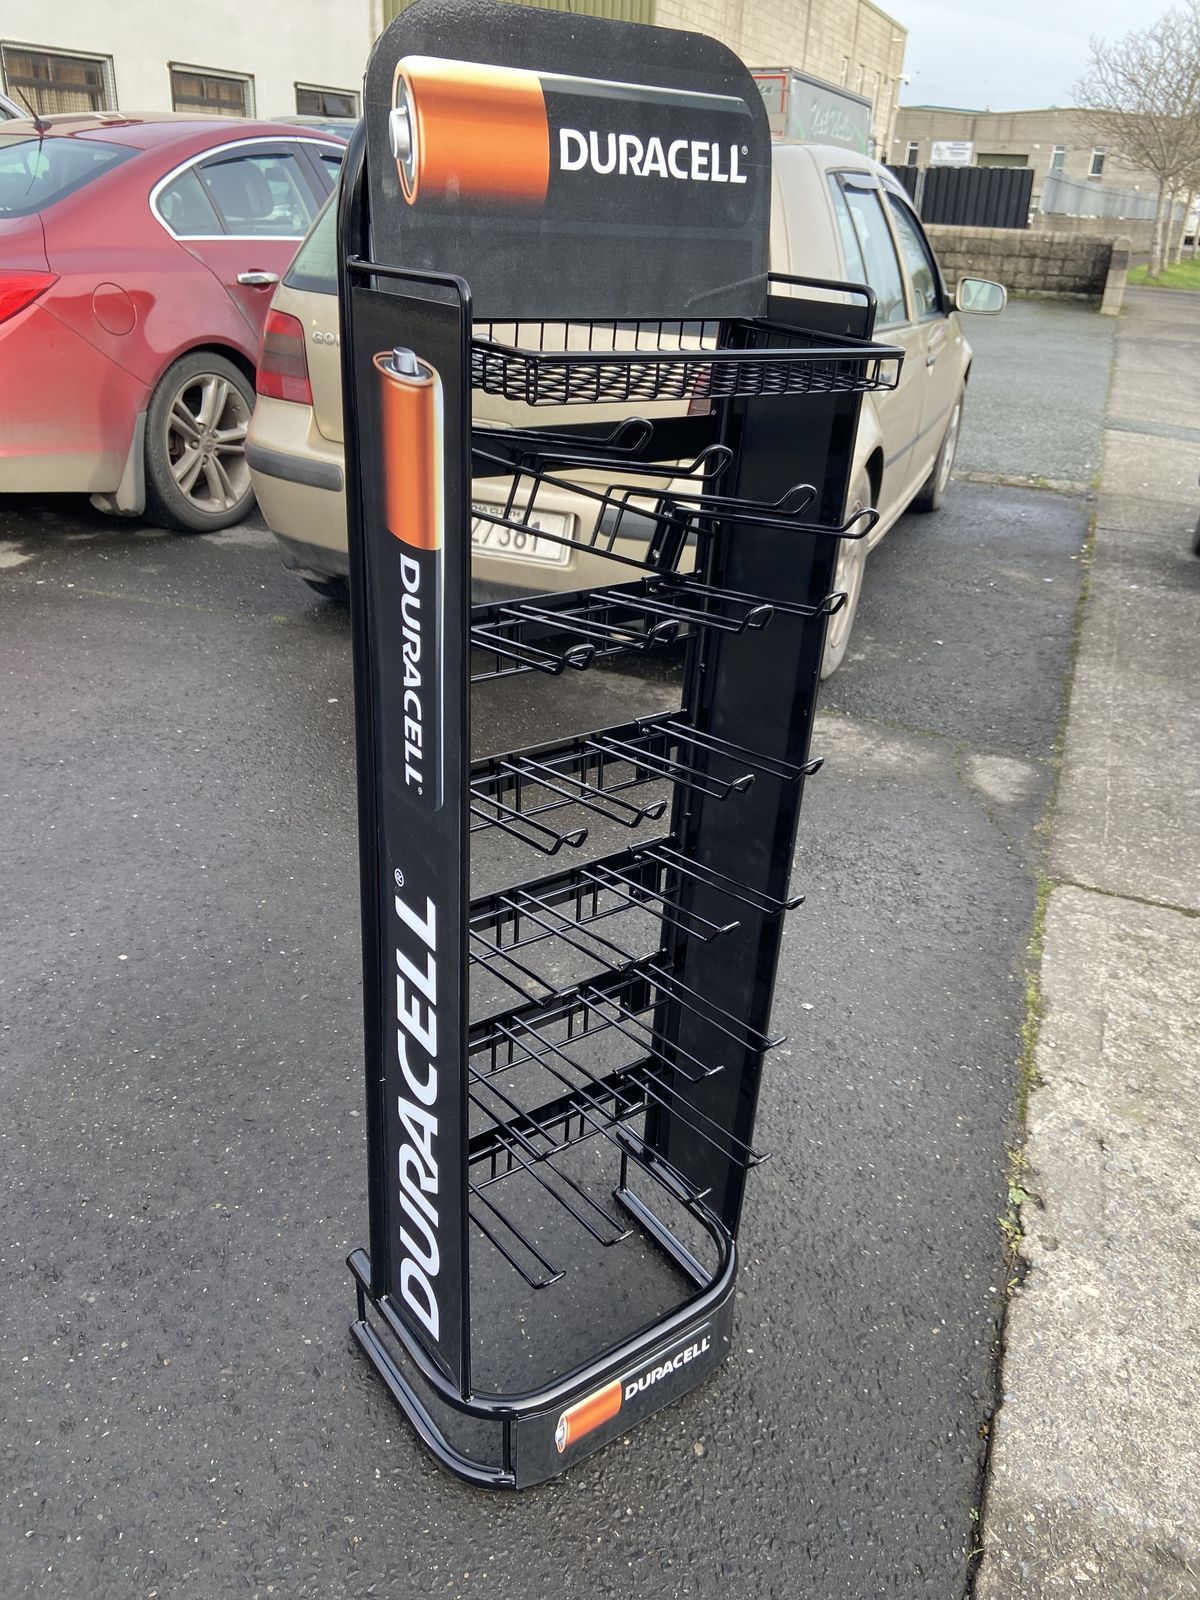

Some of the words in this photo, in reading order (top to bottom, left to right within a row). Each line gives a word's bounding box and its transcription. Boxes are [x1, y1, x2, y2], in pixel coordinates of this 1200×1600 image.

[559, 128, 748, 184] DURACELL
[312, 331, 340, 347] GO
[400, 552, 423, 787] DURACELL
[394, 895, 440, 1342] DURACELL
[624, 1337, 711, 1401] DURACELL
